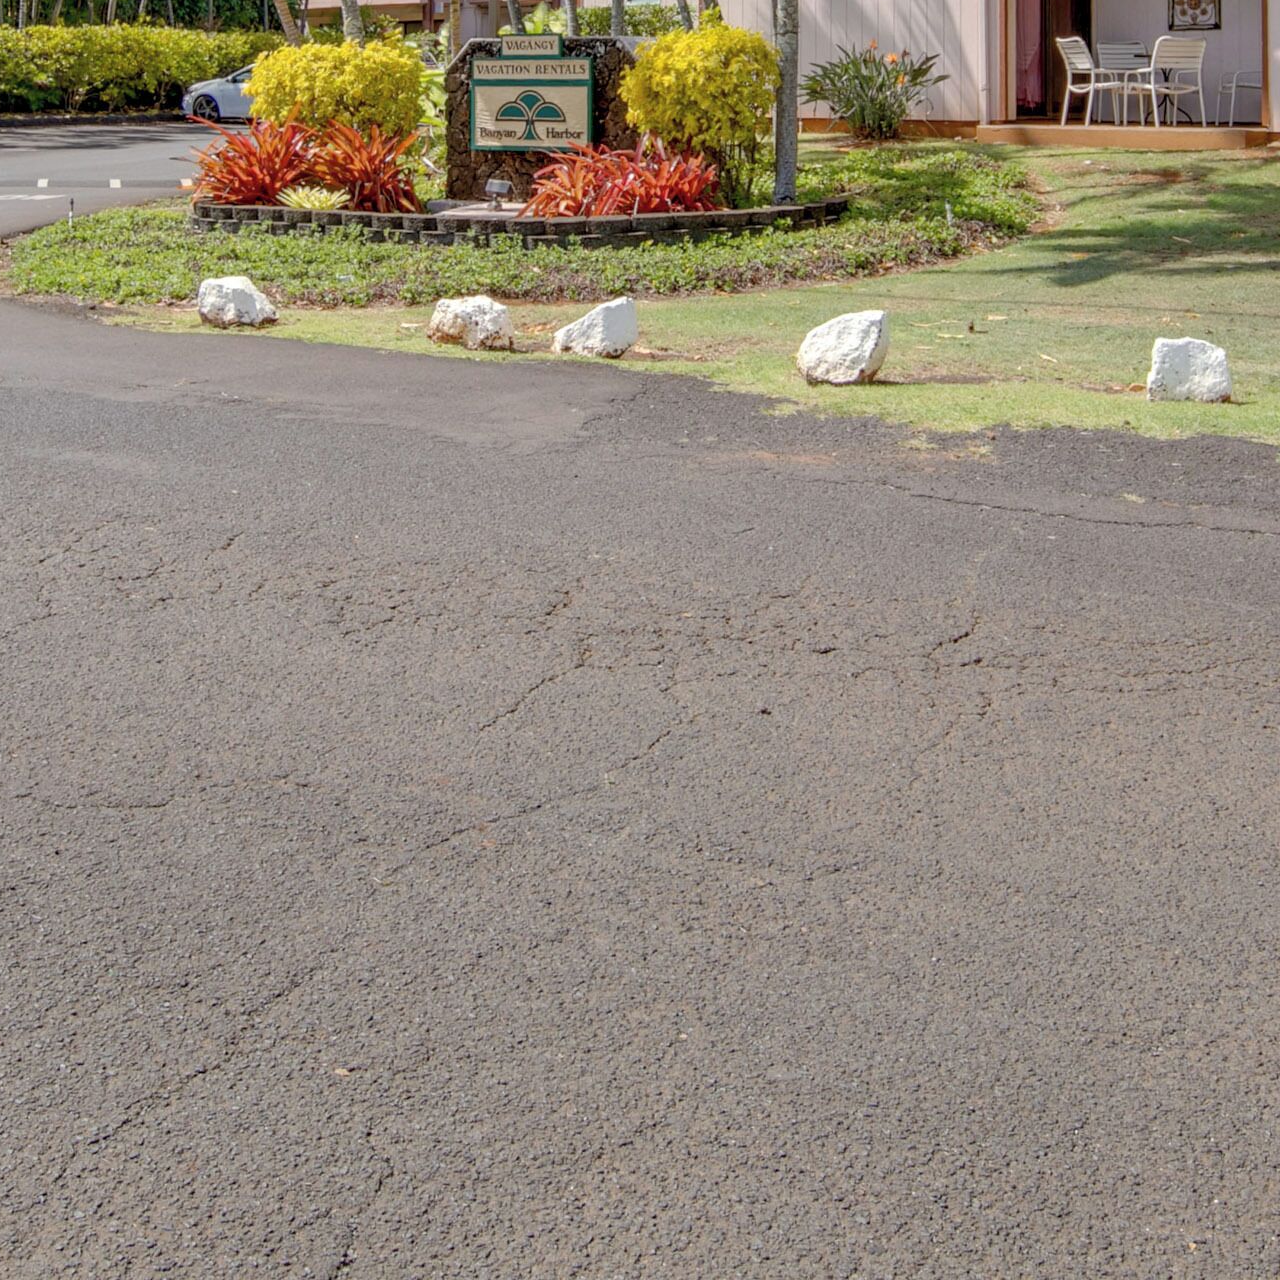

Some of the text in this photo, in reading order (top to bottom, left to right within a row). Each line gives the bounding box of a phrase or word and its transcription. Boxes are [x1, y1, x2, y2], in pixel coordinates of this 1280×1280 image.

[476, 64, 586, 75] VACATION RENTALS
[480, 127, 584, 140] Banyan Harbor
